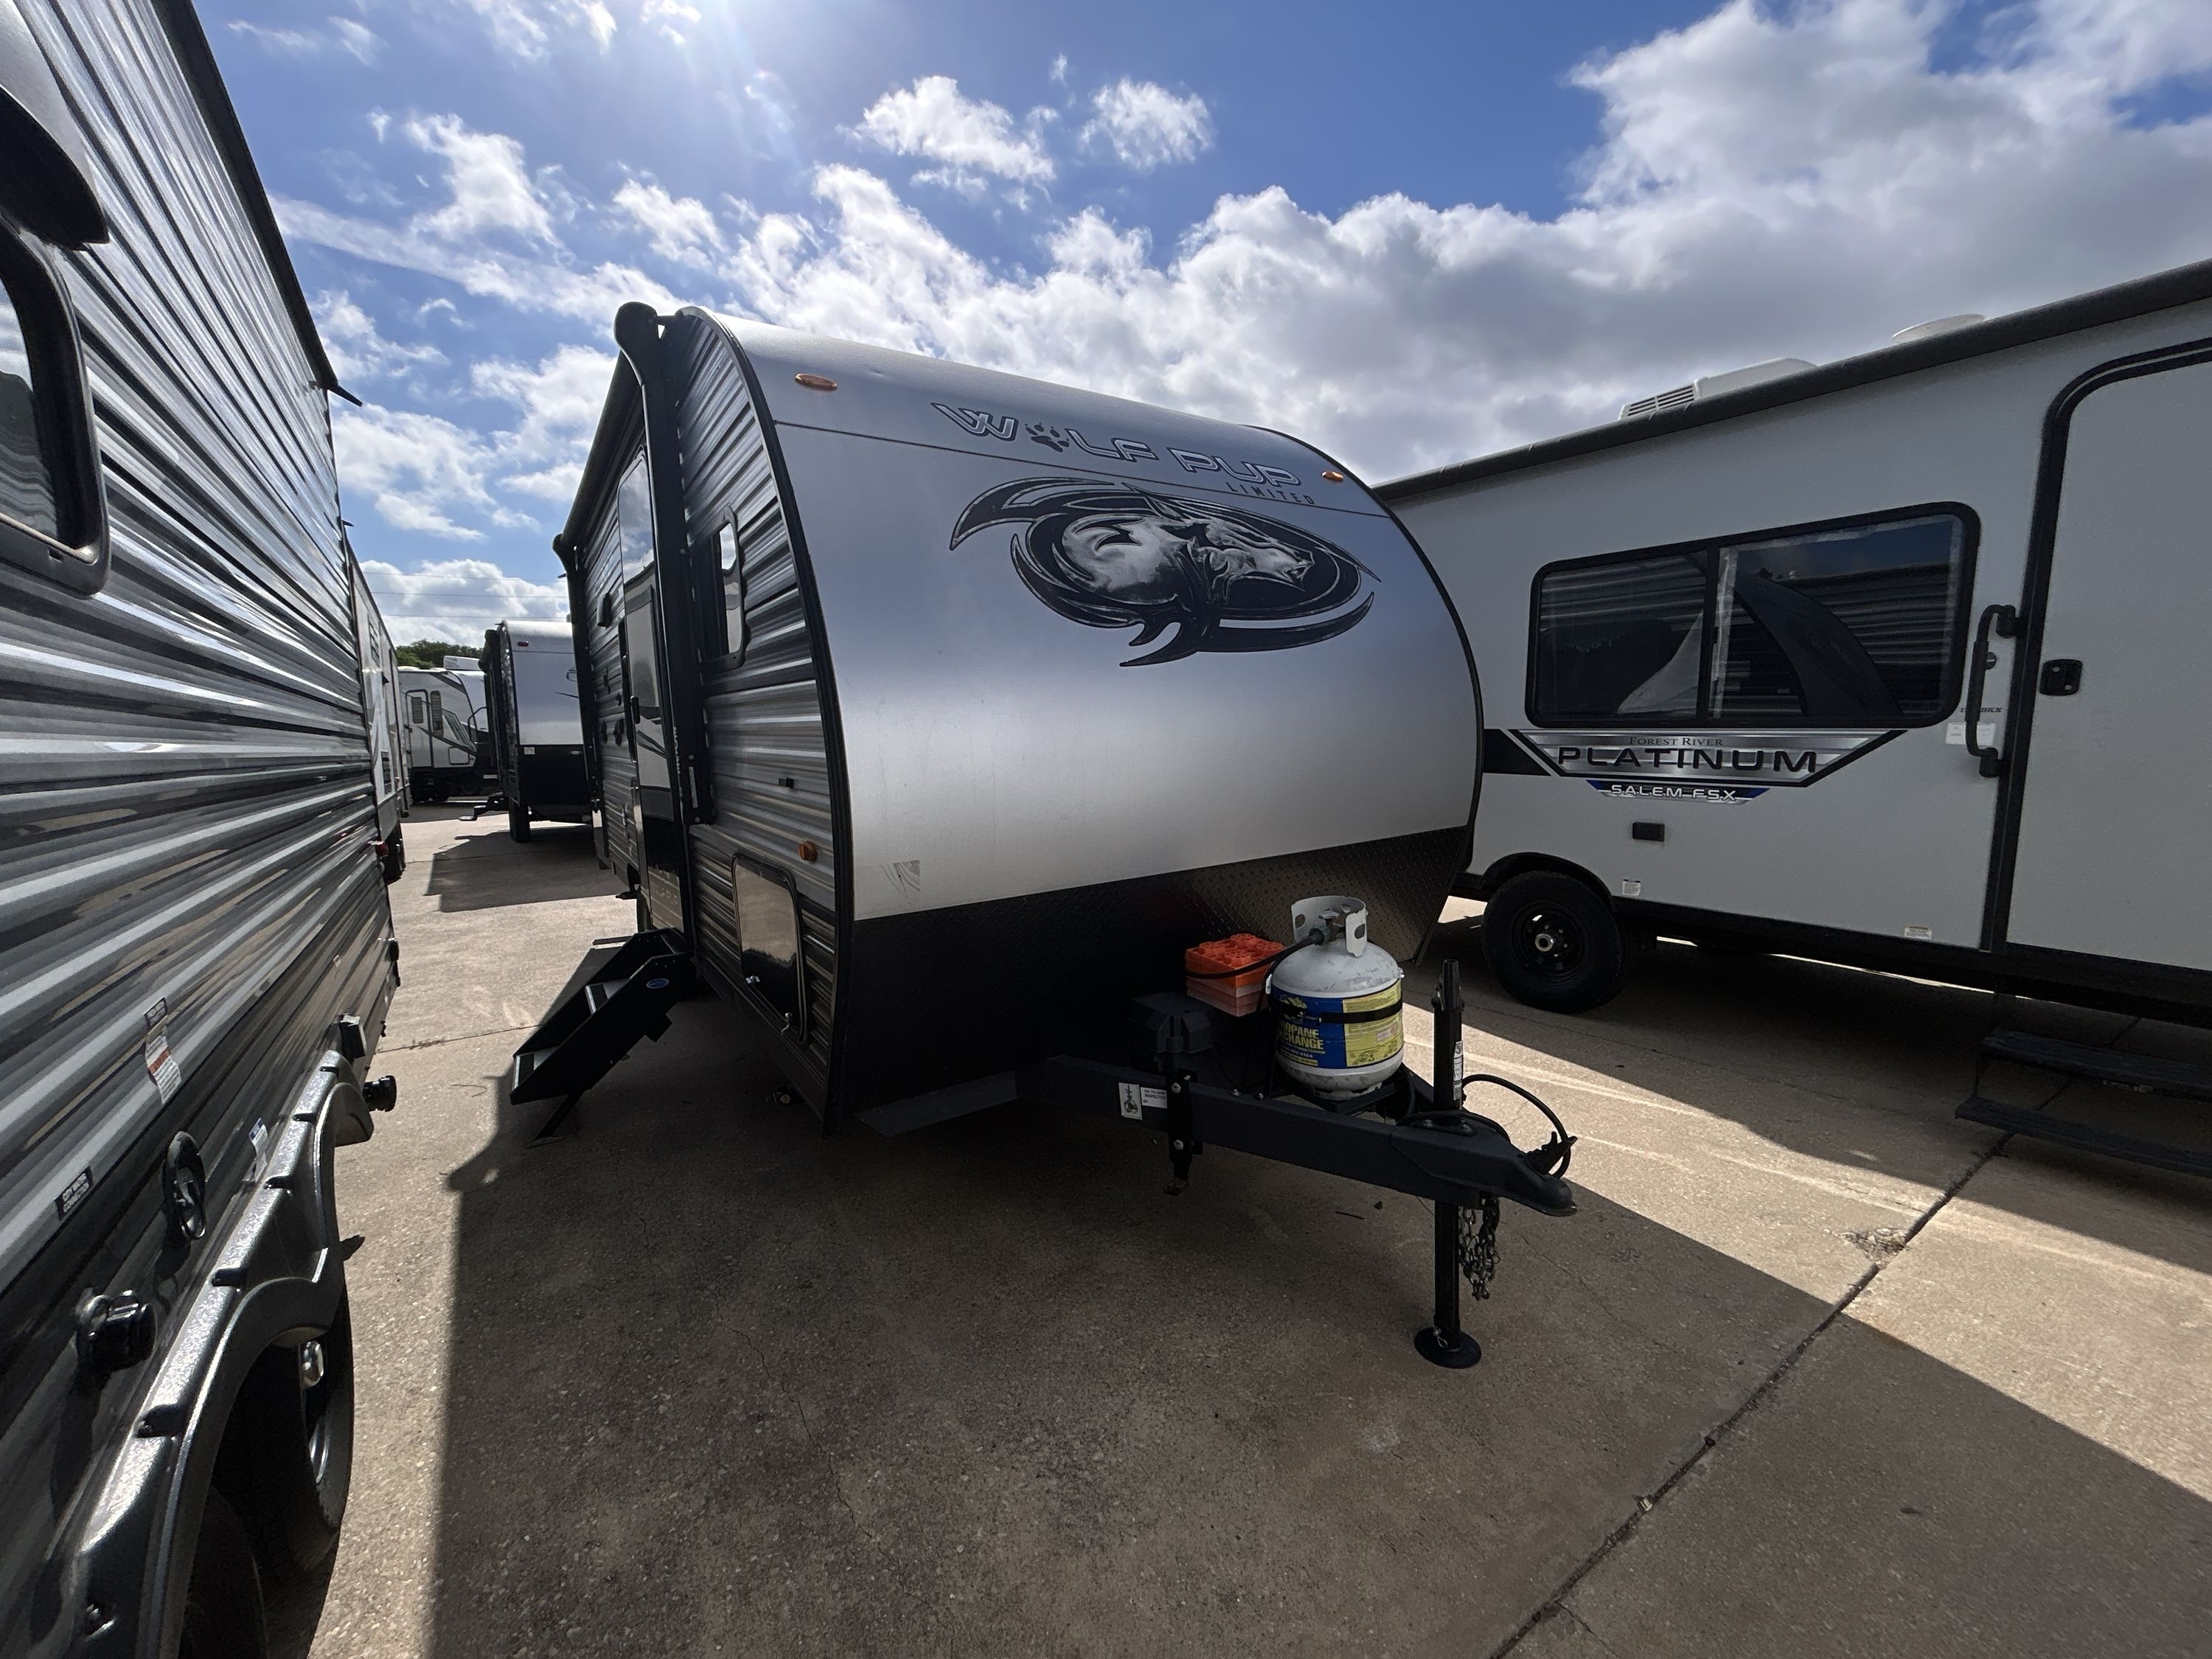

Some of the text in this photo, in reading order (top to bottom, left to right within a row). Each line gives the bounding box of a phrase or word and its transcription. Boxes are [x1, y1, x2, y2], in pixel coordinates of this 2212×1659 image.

[1166, 448, 1301, 487] PUP
[1225, 481, 1315, 504] LIMITED
[1630, 737, 1723, 746] FOREST RIVER
[1558, 746, 1817, 773] PLATINUM
[1610, 784, 1736, 800] SALEM FSX
